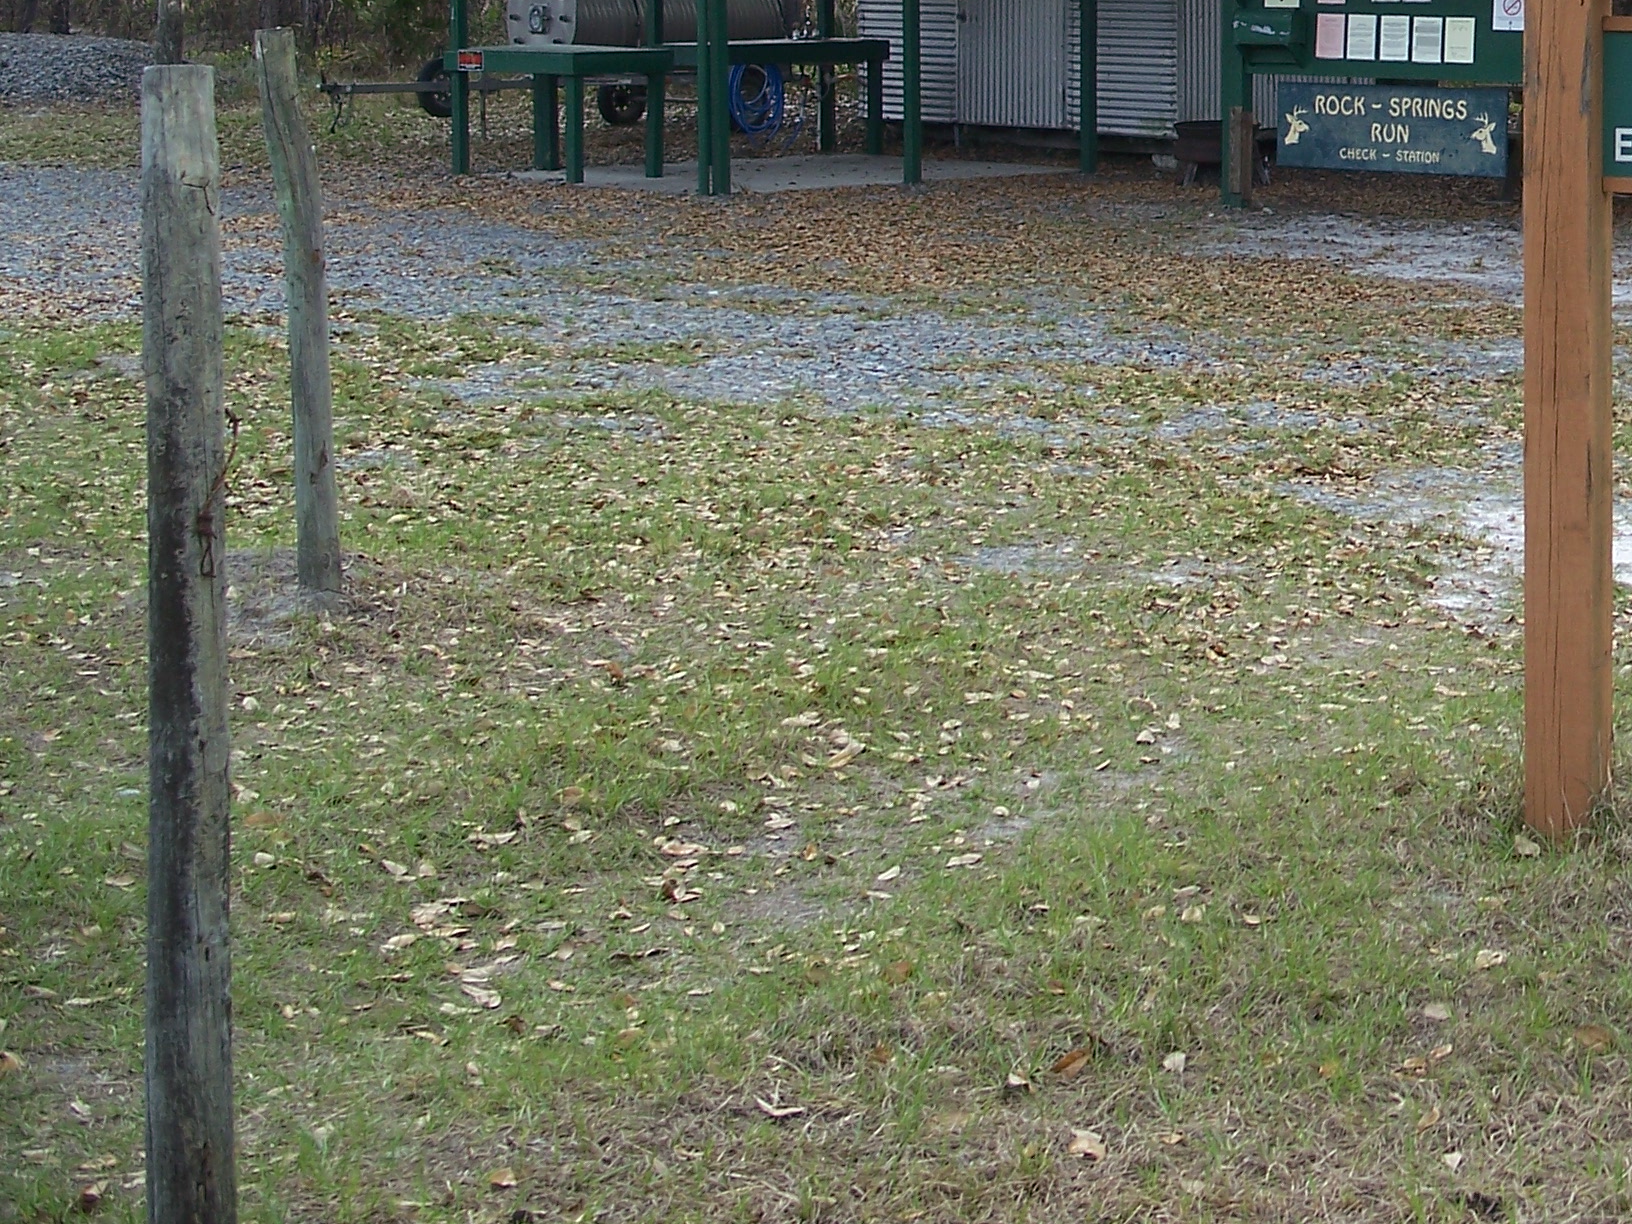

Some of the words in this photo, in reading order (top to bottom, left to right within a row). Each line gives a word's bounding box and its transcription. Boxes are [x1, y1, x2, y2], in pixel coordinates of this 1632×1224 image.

[1314, 94, 1366, 116] ROCK
[1388, 97, 1468, 120] SPRINGS
[1370, 122, 1410, 143] RUN
[1338, 147, 1377, 161] CHECK
[1395, 149, 1440, 163] STATION
